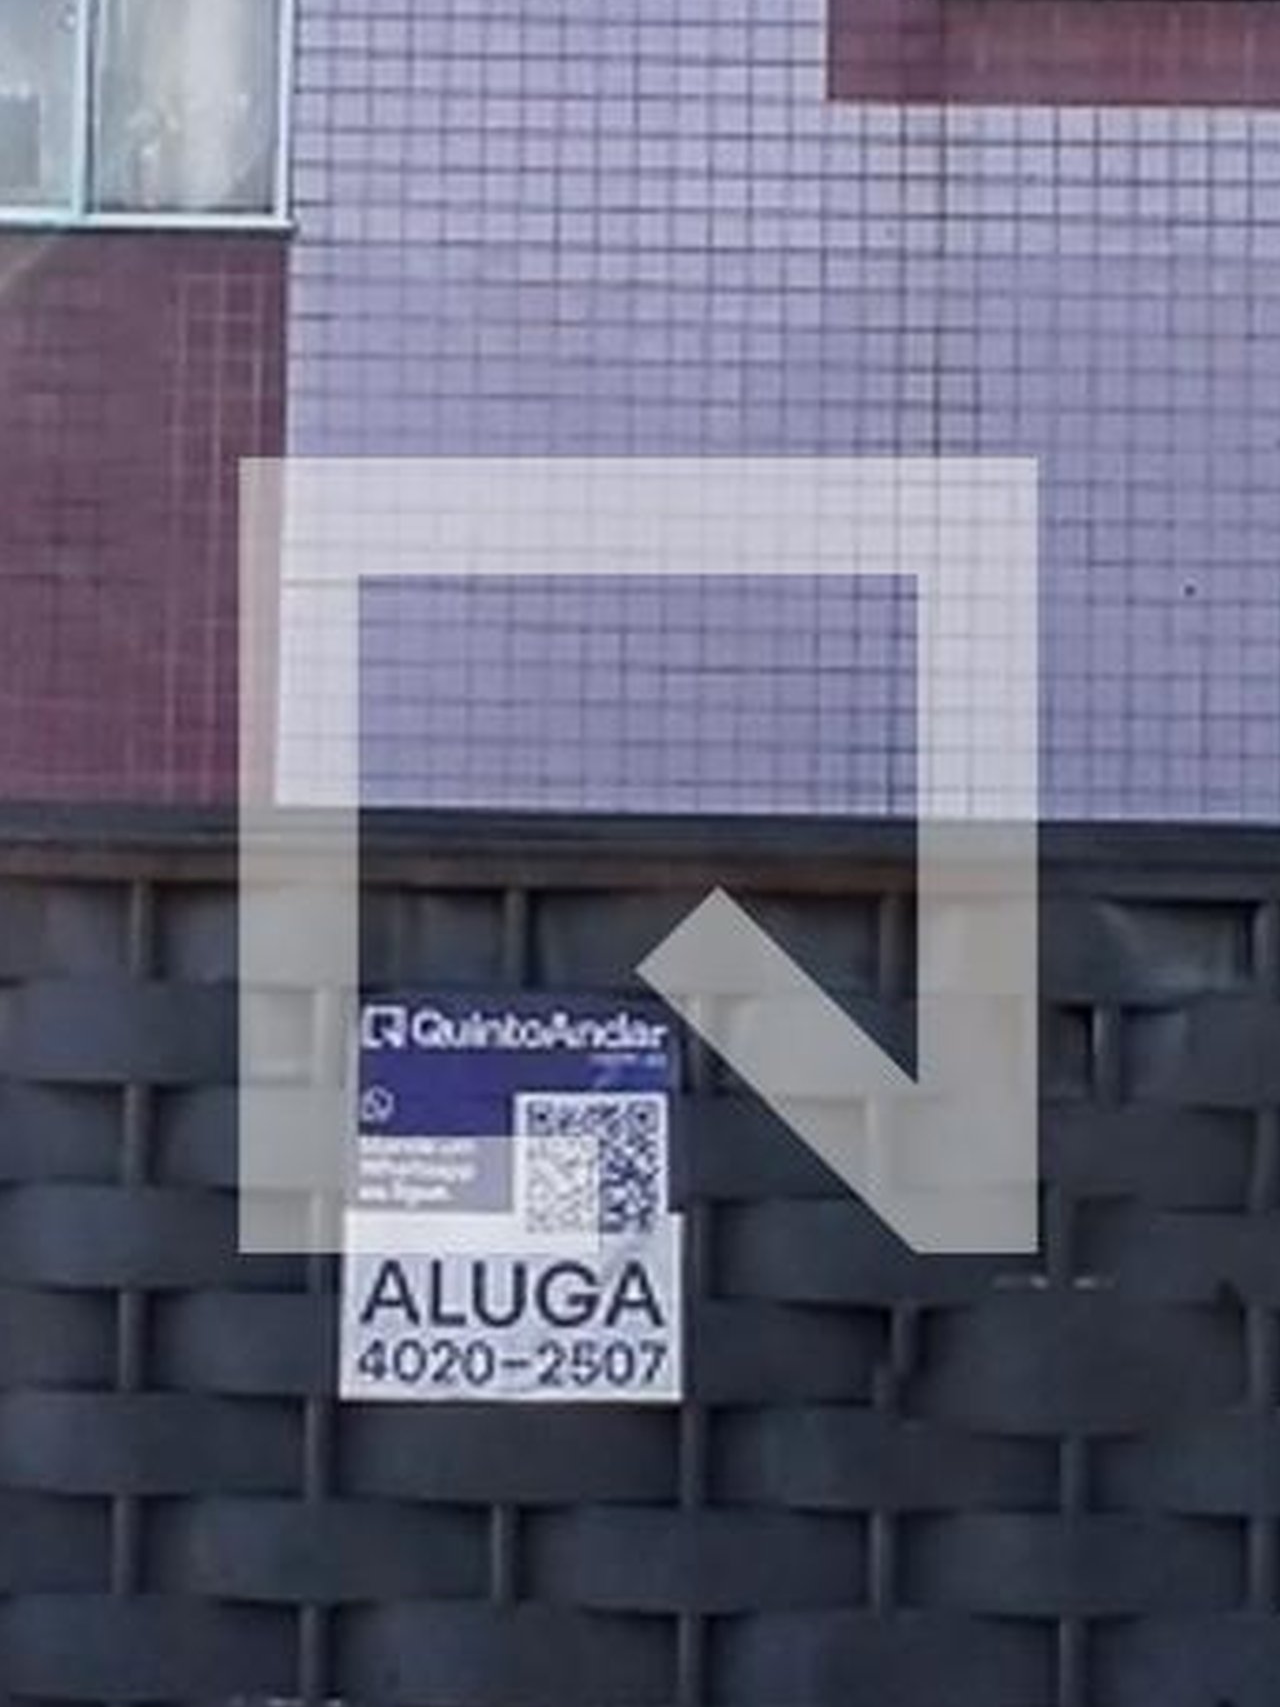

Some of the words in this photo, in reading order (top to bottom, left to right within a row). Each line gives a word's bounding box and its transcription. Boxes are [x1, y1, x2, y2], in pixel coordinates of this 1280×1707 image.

[412, 1009, 669, 1049] QuintoAndar
[358, 1259, 665, 1328] ALUGA
[357, 1338, 669, 1386] 4020-2507
